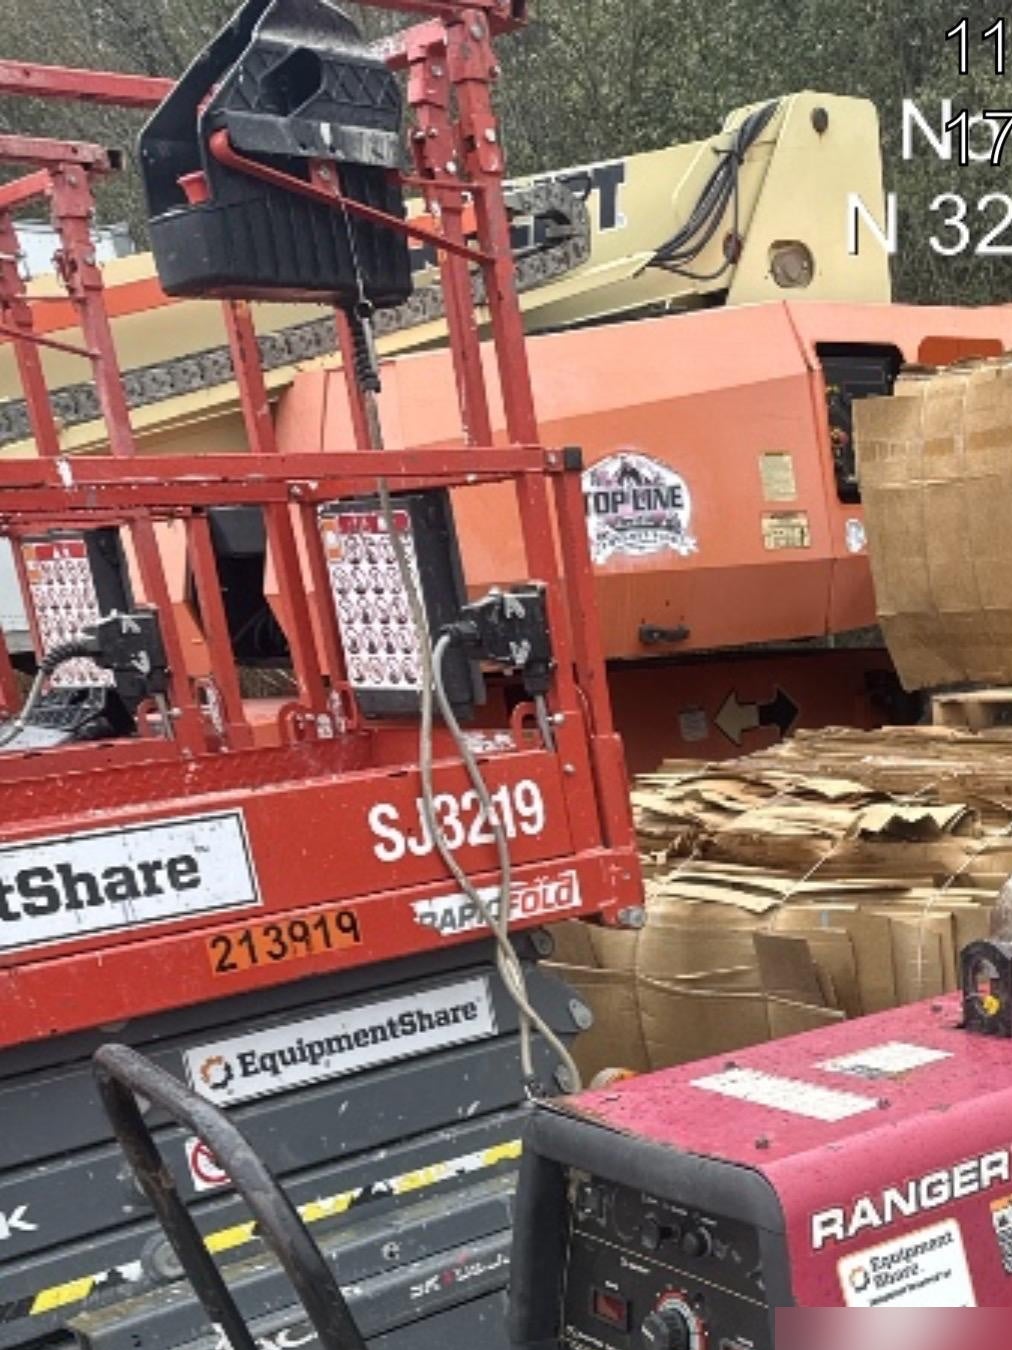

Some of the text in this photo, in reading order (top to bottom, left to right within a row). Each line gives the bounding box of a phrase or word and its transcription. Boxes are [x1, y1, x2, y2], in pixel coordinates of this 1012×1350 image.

[632, 484, 684, 511] LINE
[368, 779, 546, 862] SJ3219
[211, 911, 360, 972] 213919
[237, 1000, 478, 1077] EquipmentShare
[811, 1149, 1011, 1250] RANGER
